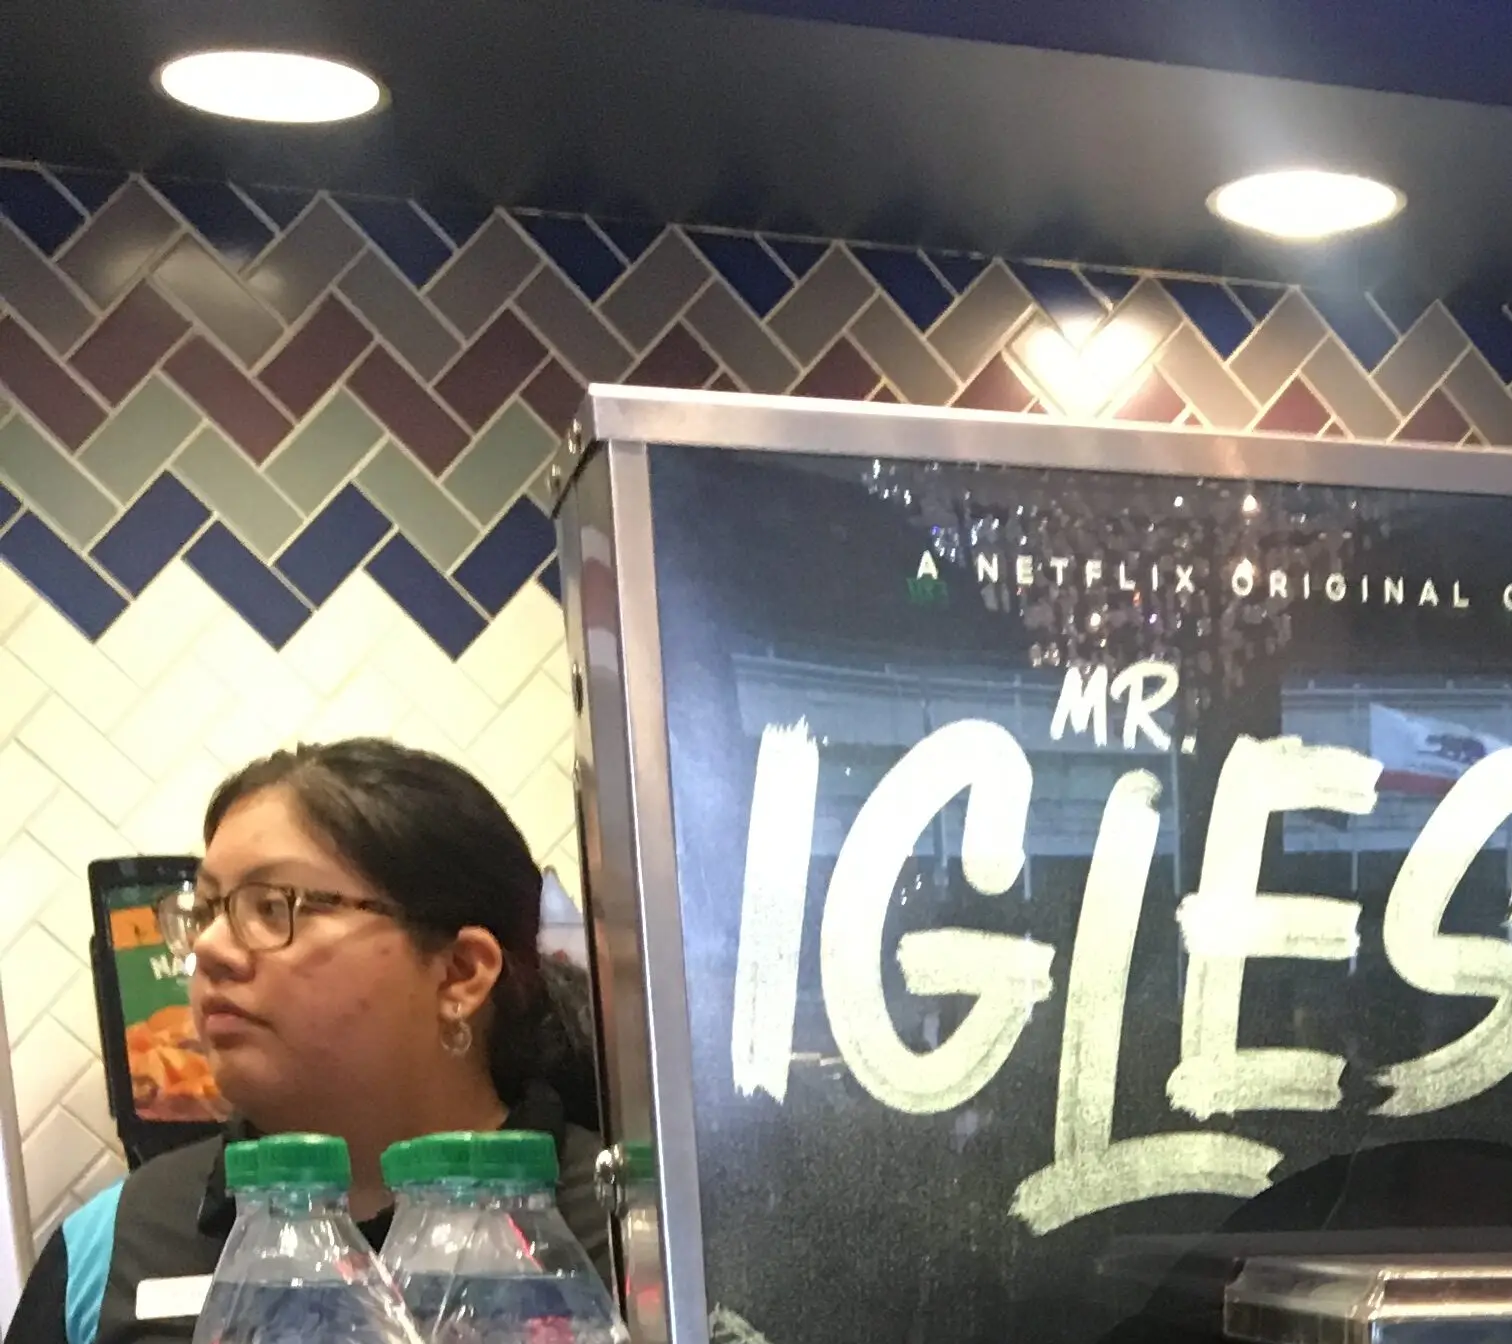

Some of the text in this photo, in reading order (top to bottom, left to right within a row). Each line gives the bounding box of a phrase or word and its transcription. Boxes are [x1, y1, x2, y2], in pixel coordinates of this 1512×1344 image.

[916, 550, 939, 580] A
[977, 552, 1196, 593] NETFLIX
[1230, 562, 1470, 609] ORIGINAL
[1050, 659, 1197, 754] MR.
